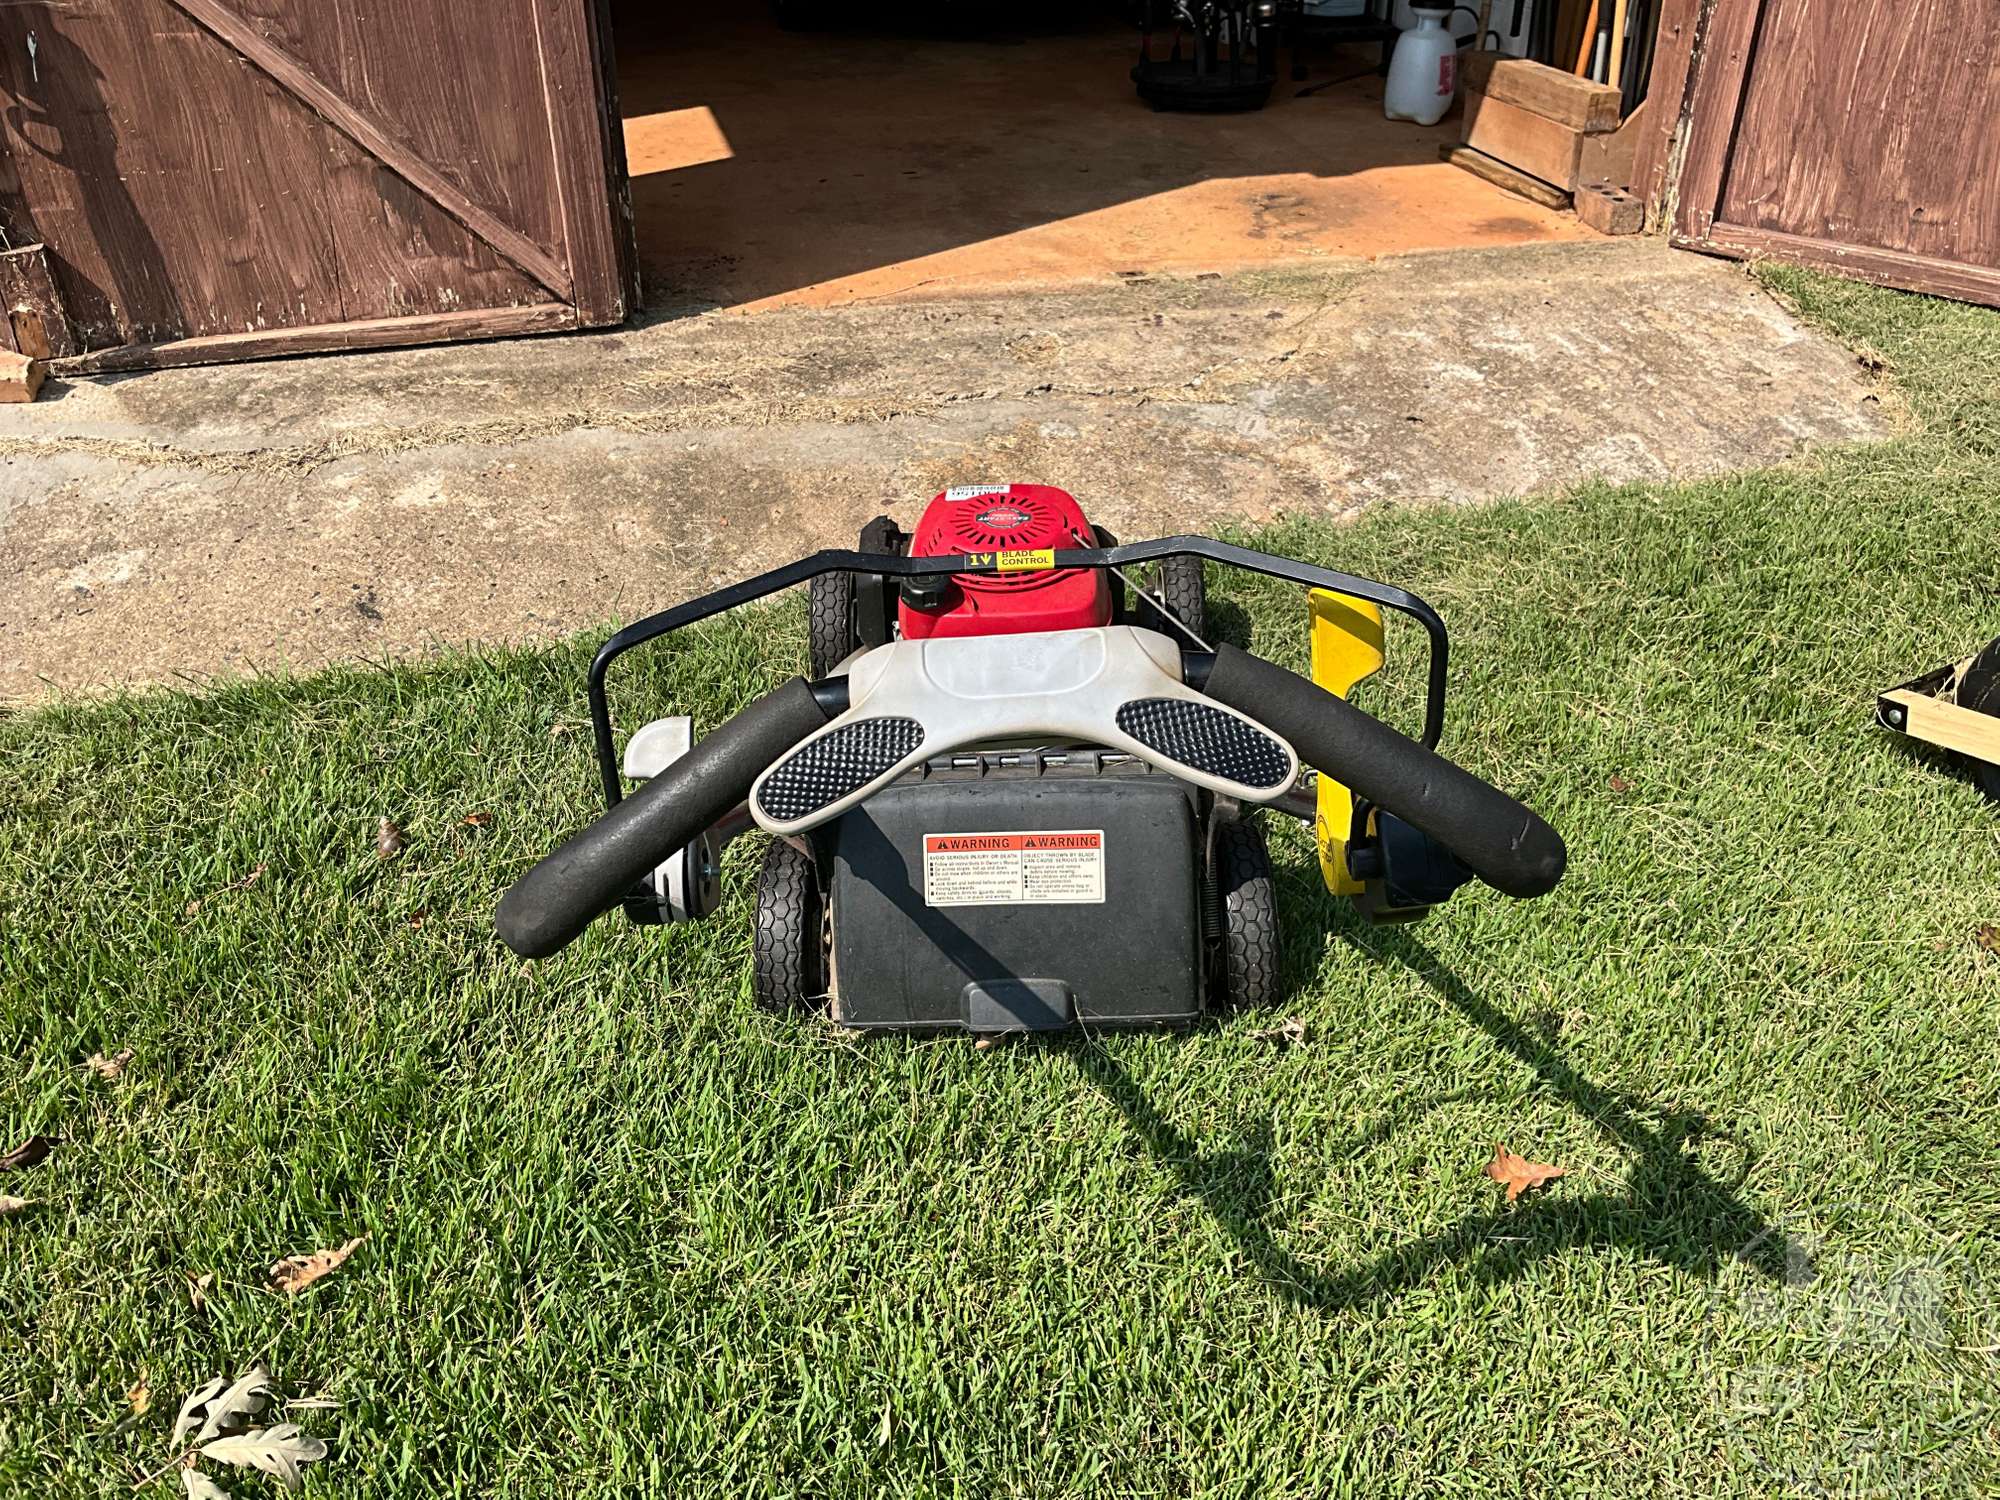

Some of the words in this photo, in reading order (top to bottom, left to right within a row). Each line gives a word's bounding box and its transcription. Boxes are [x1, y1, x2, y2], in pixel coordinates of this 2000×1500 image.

[1001, 557, 1049, 566] CONTROL
[951, 838, 1010, 849] WARNING
[1038, 837, 1098, 847] WARNING
